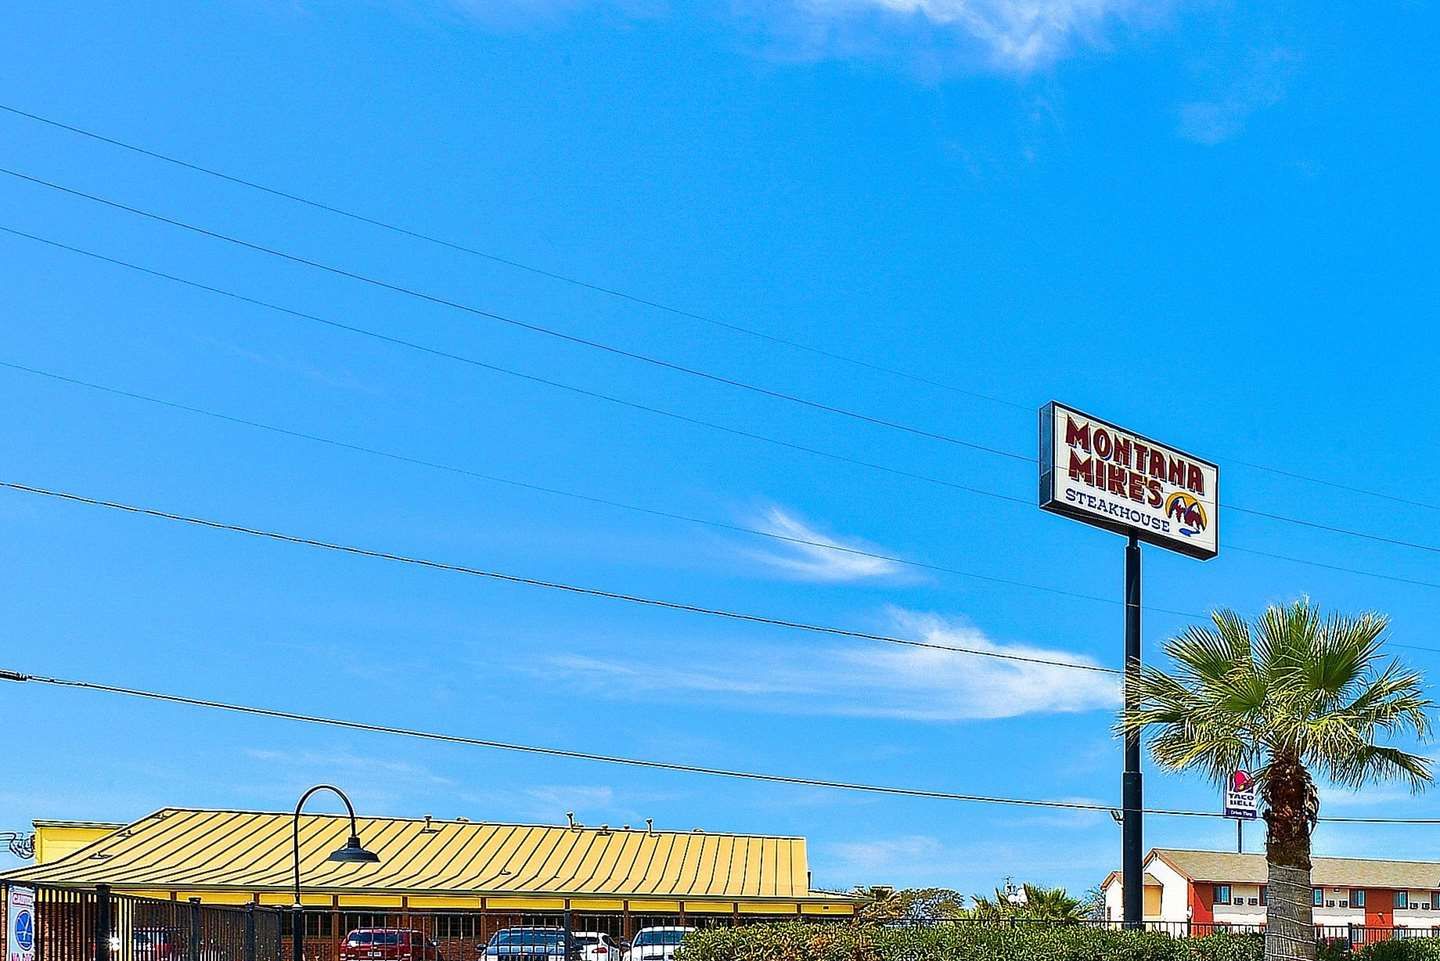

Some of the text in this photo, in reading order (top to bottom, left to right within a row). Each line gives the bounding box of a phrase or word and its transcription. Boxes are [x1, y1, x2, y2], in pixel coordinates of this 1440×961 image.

[1065, 413, 1205, 496] MONTANA
[1068, 448, 1164, 509] MIKE'S
[1065, 488, 1171, 533] STEAKHOUSE
[1228, 793, 1254, 801] TACO
